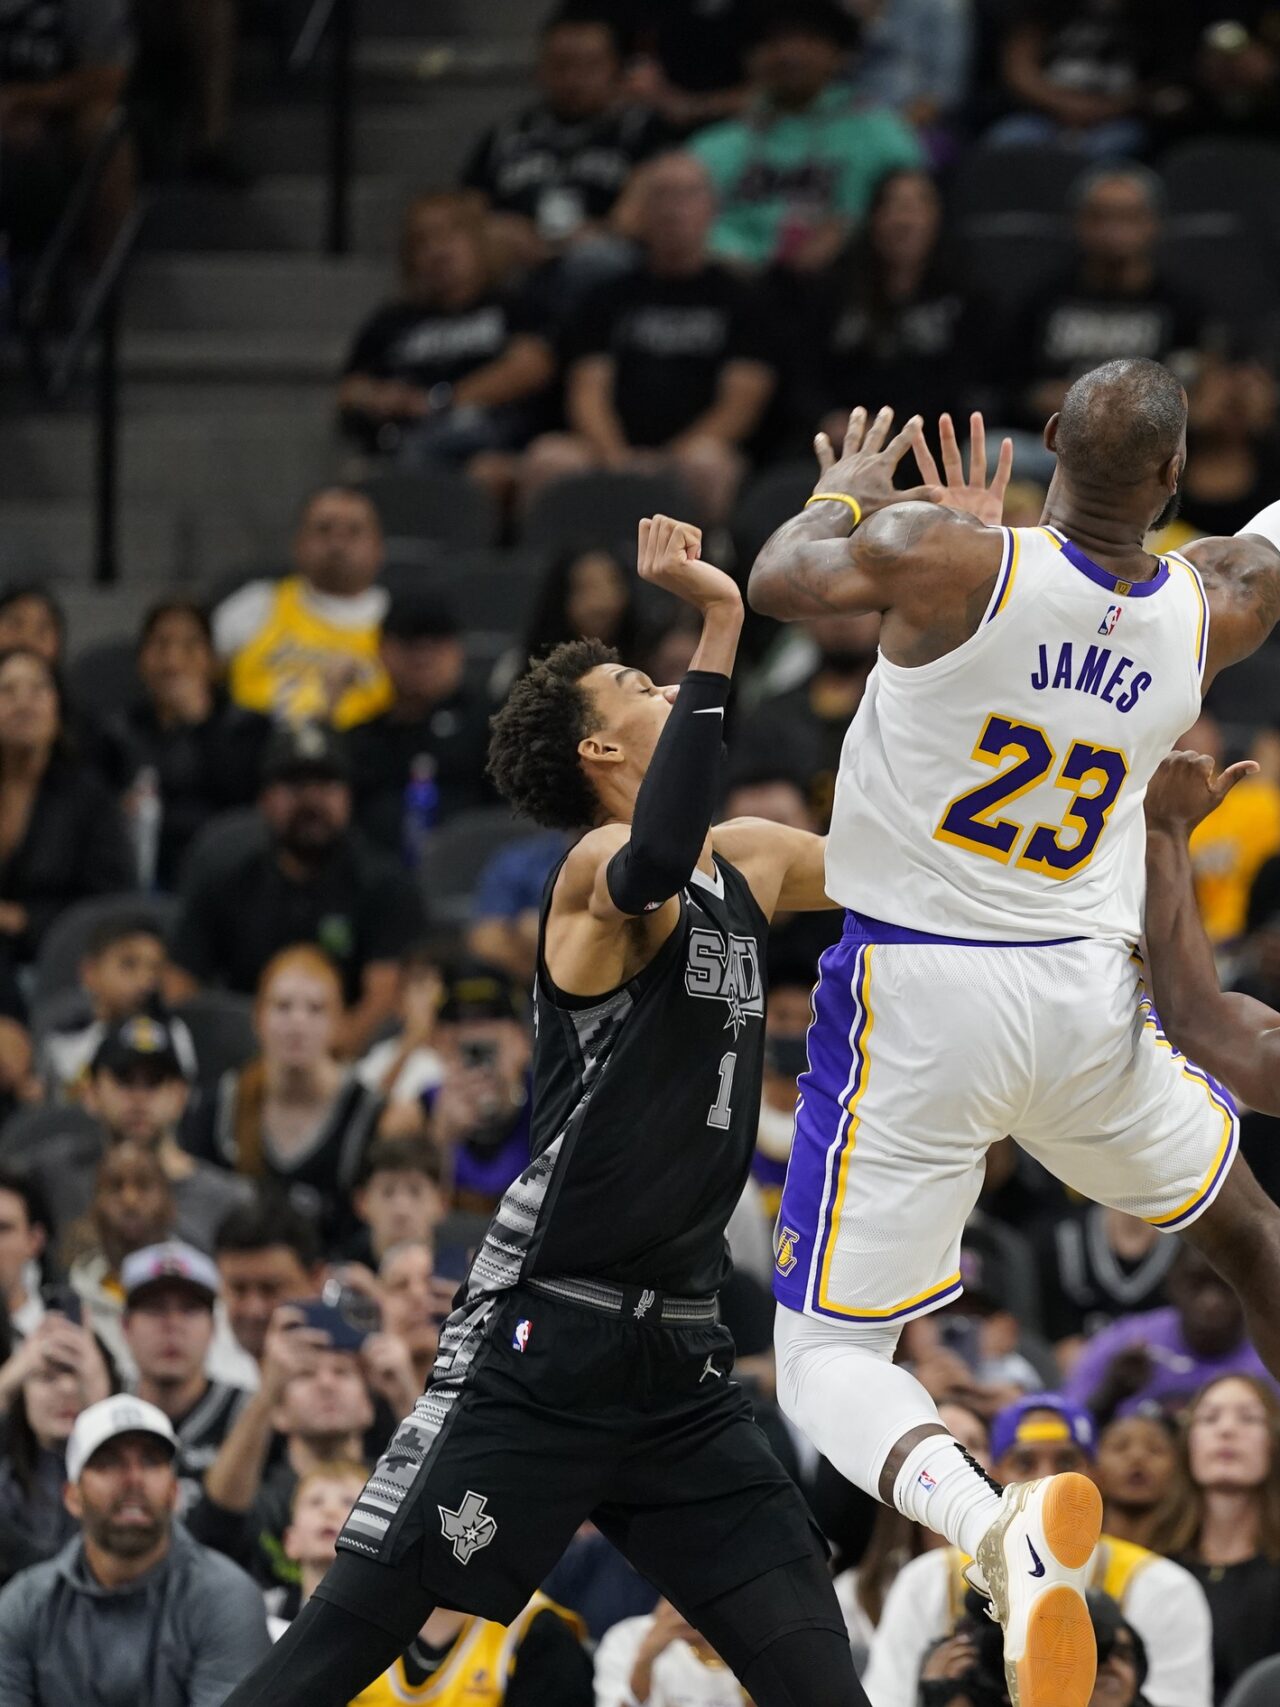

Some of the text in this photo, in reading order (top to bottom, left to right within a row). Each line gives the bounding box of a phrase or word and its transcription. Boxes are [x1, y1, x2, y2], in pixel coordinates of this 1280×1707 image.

[1031, 643, 1152, 713] JAMES
[932, 712, 1130, 881] 23
[706, 1051, 737, 1130] 1
